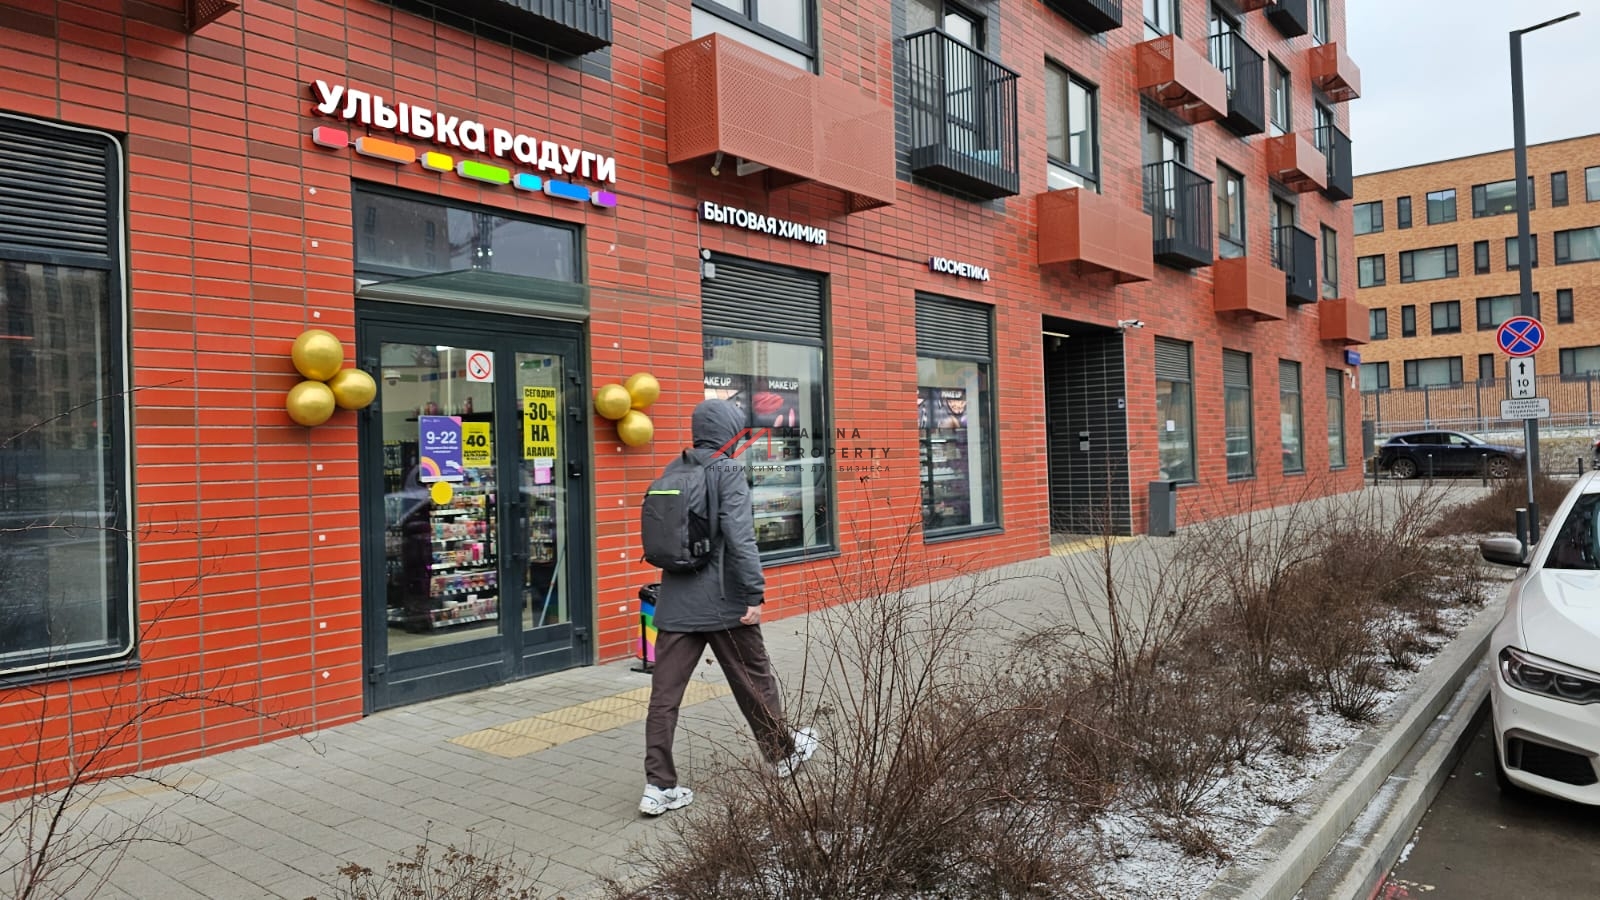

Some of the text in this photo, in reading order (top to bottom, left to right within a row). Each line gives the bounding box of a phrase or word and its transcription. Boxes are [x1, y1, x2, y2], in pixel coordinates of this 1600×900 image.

[704, 200, 827, 246] БЫТОВАЯ ХИМИЯ
[933, 256, 990, 281] КОСМЕТИКА
[704, 376, 732, 387] AKE UP
[768, 380, 799, 390] MAKE UP
[1517, 379, 1530, 387] 10
[525, 388, 555, 399] СЕГОДНЯ
[426, 431, 457, 445] 9-22
[531, 425, 550, 442] НА
[526, 446, 555, 457] ARAVIA
